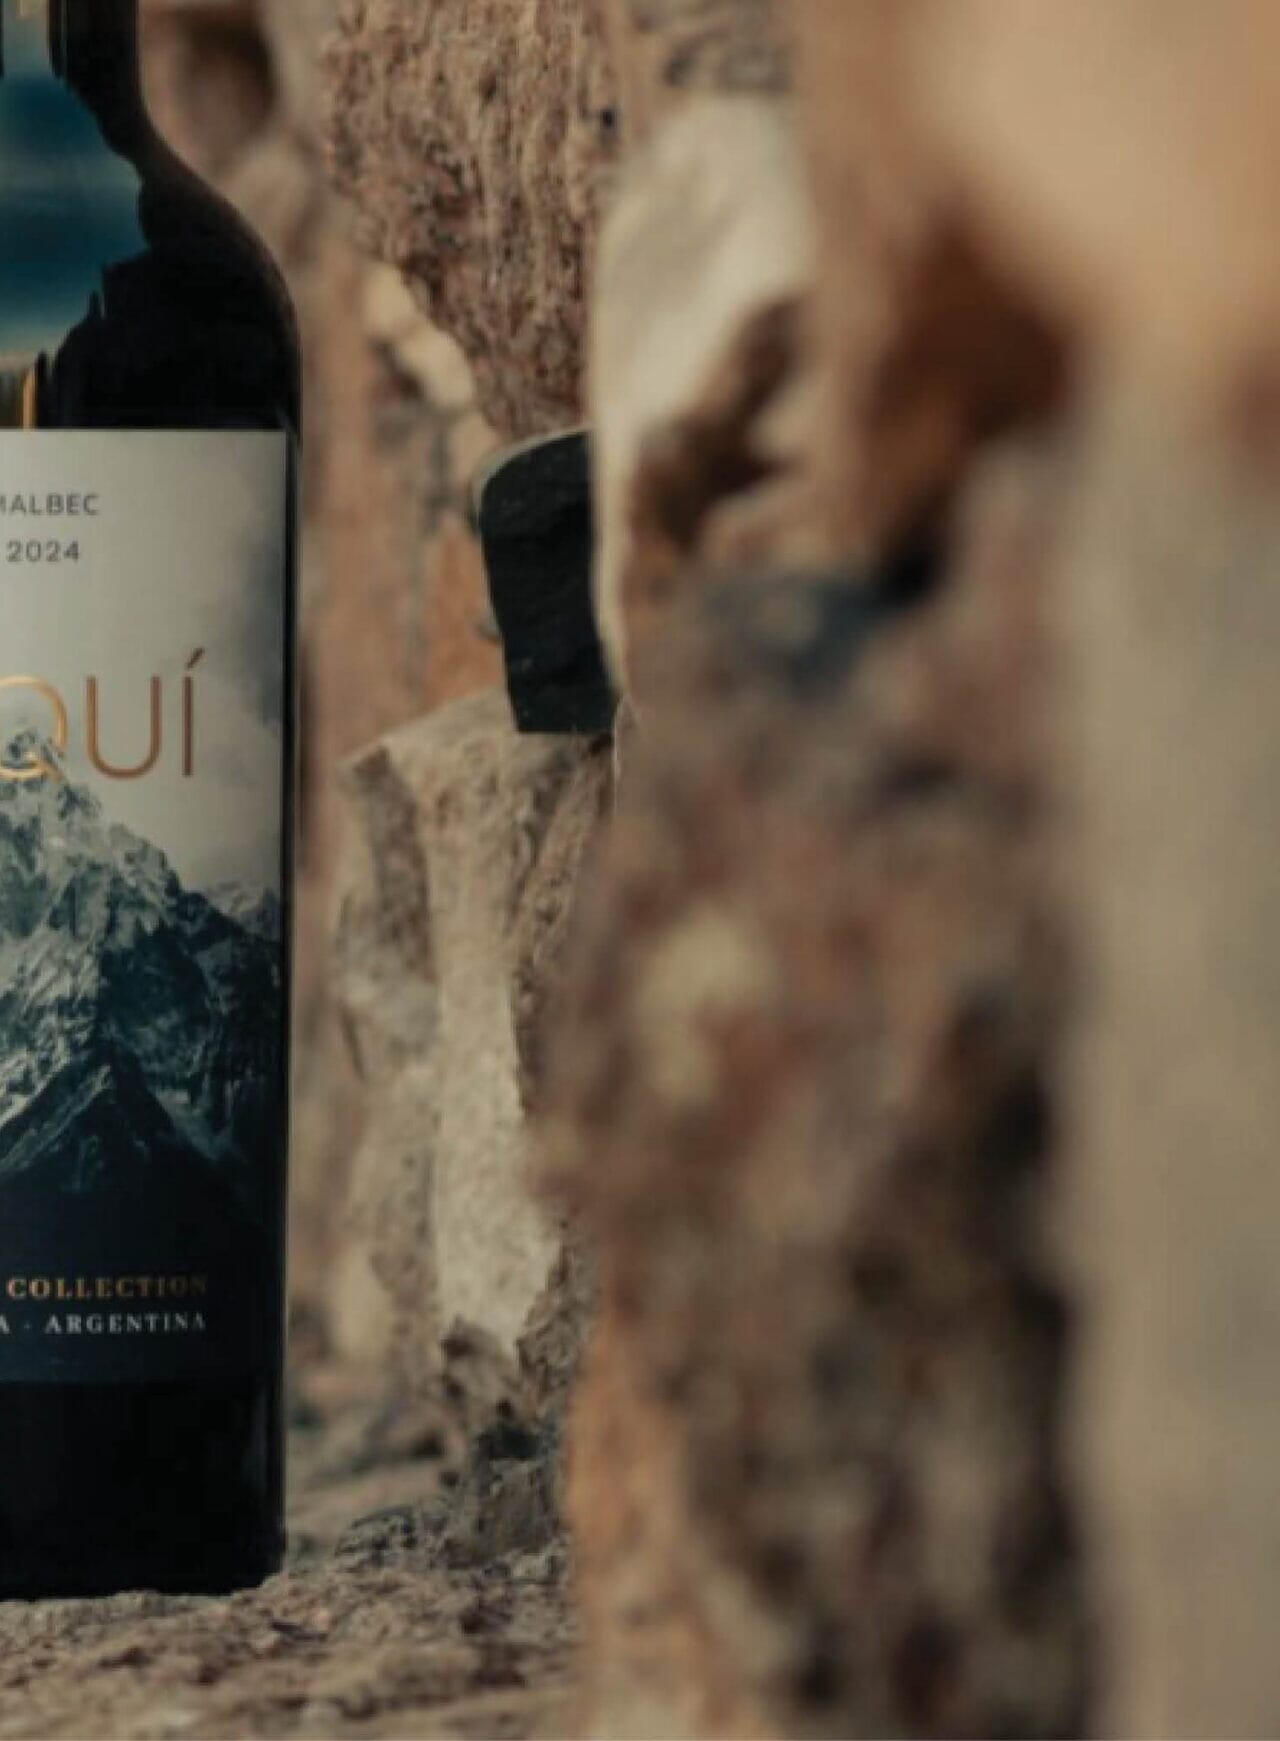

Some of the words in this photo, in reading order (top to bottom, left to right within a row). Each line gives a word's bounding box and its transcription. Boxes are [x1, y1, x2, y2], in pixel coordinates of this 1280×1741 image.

[6, 540, 81, 563] 2024
[7, 1274, 208, 1300] COLLECTION
[44, 1310, 206, 1335] ARGENTINA
